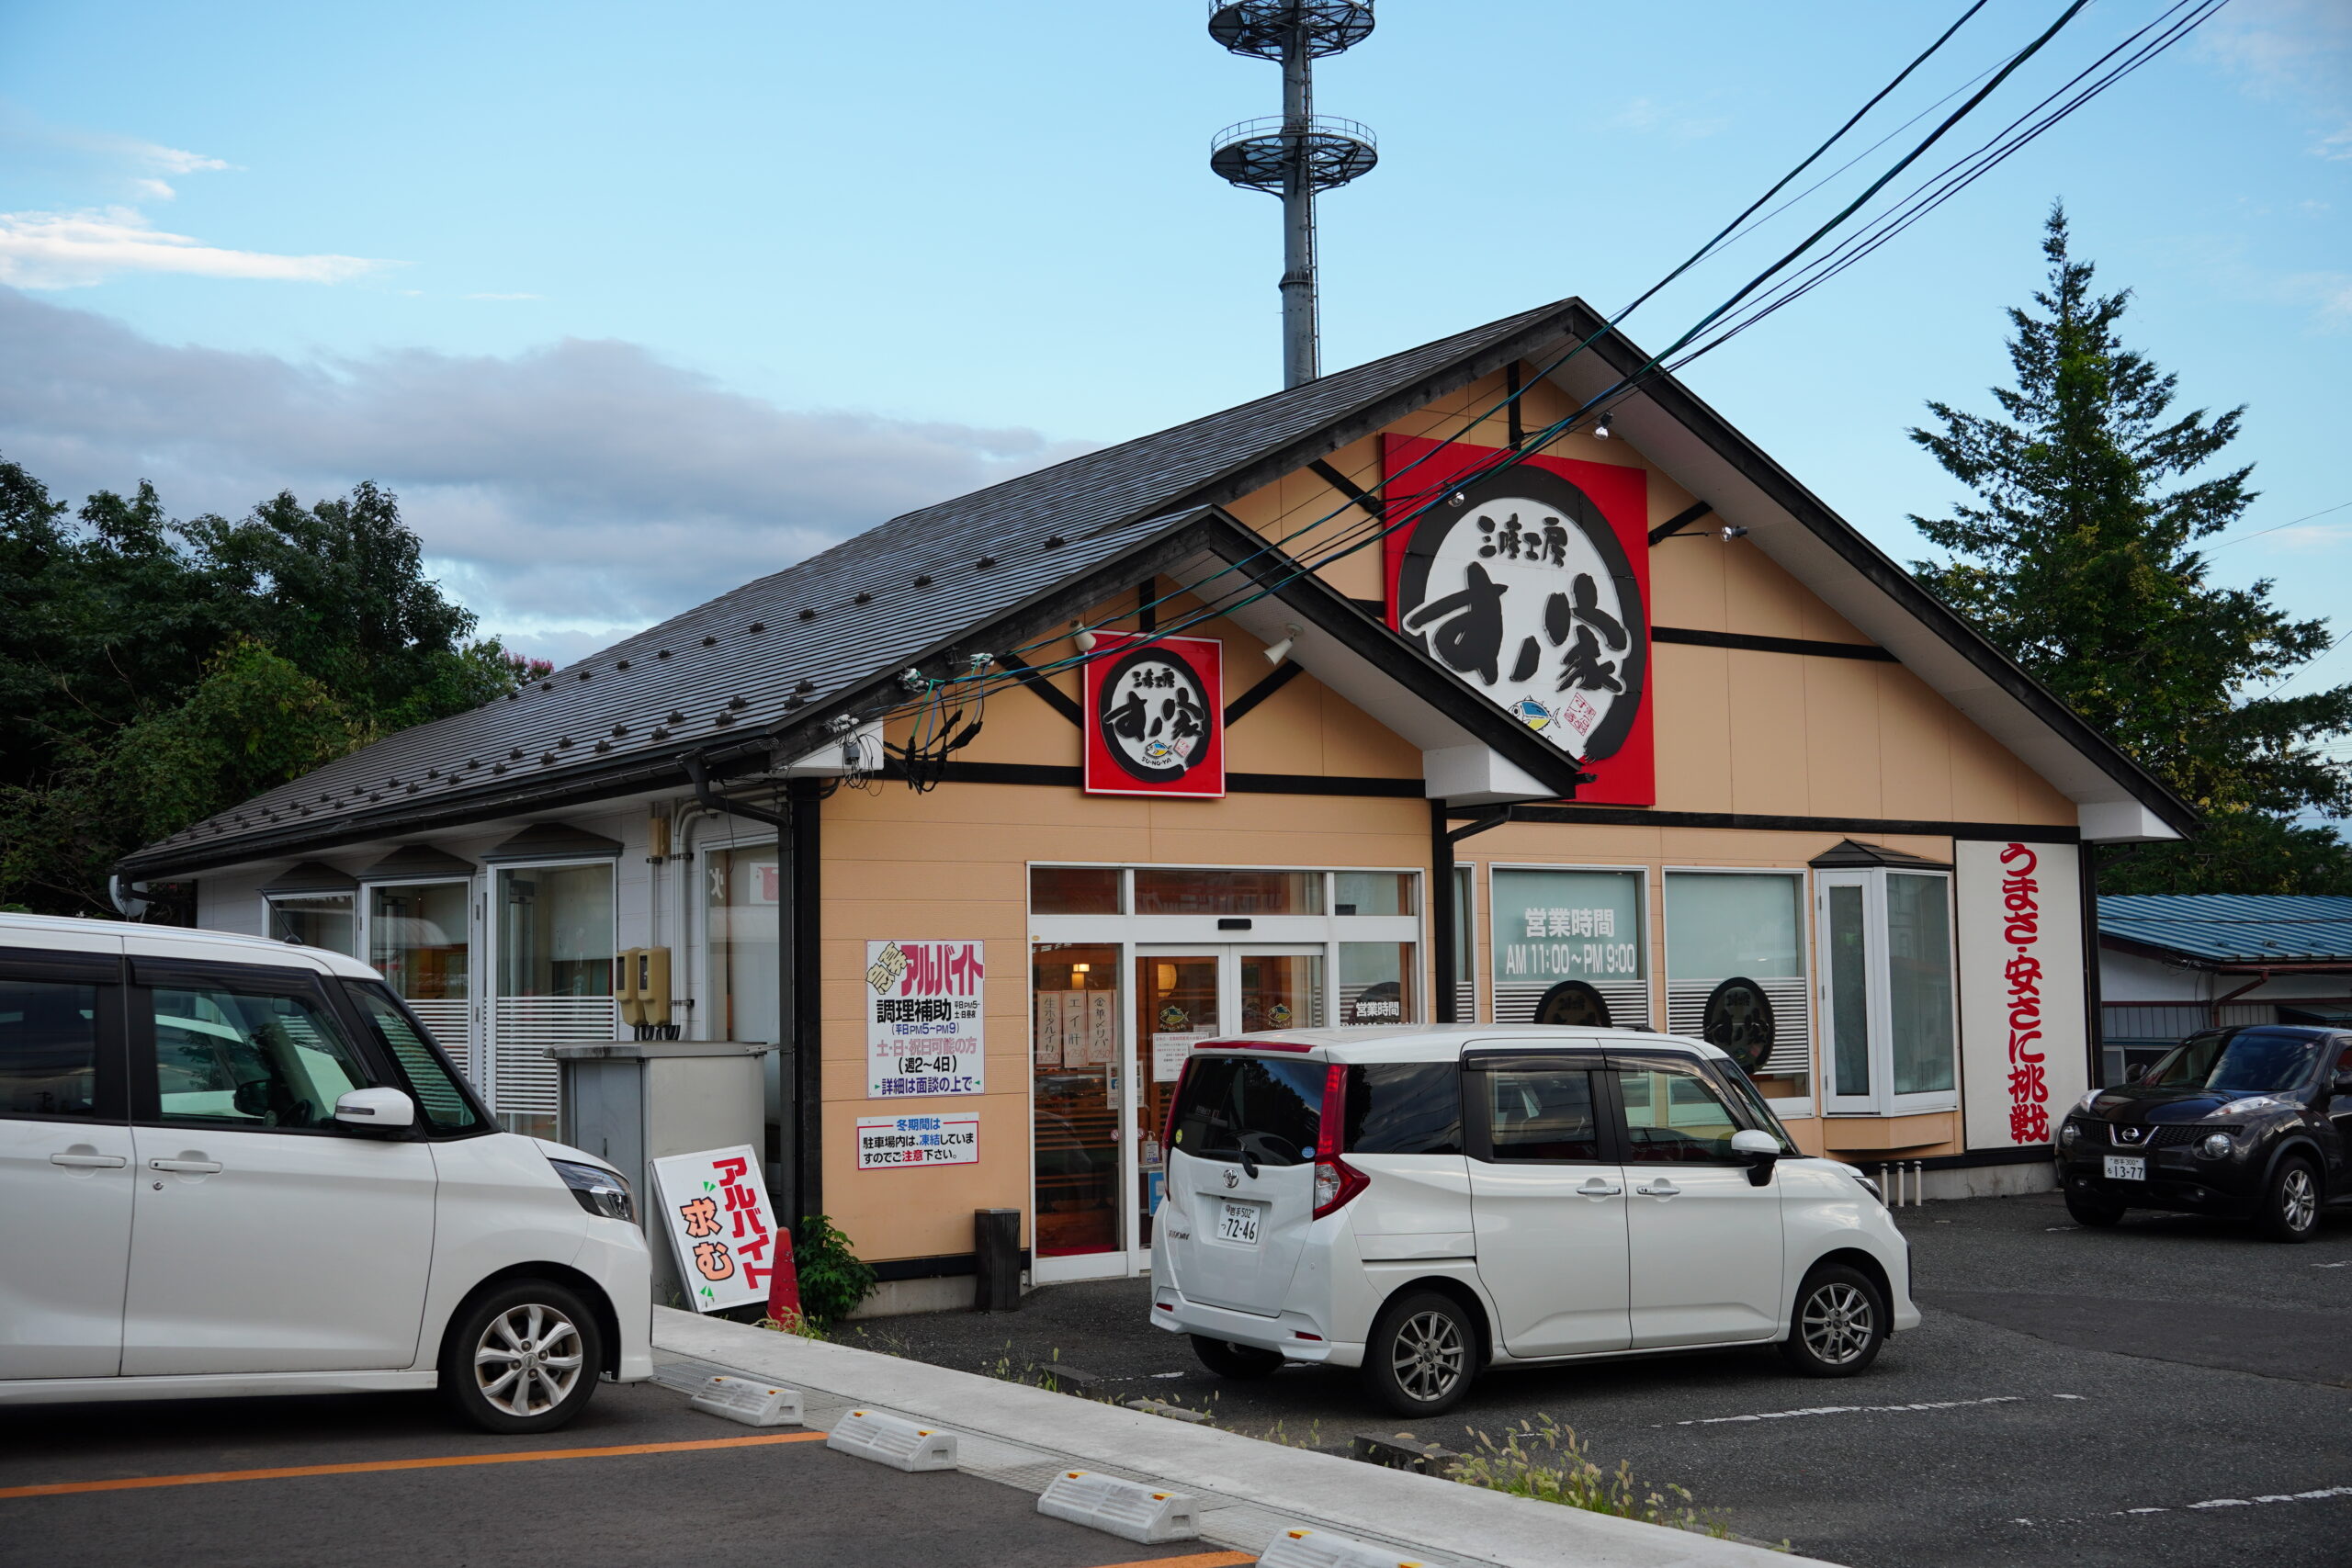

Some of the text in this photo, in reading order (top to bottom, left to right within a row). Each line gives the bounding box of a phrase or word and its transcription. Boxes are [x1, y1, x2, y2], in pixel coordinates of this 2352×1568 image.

[1525, 908, 1615, 938] 営業時間
[866, 942, 908, 995] 急募
[900, 944, 983, 997] アルバイト
[2000, 842, 2050, 1145] うまさ・安さに挑戦
[876, 998, 951, 1023] 調理補助
[1356, 1001, 1399, 1017] 営業時間
[876, 1036, 977, 1056] 土・日・祝日可能の方
[882, 1076, 972, 1095] 詳細は面談の上で
[897, 1118, 940, 1132] 冬期間は
[863, 1133, 974, 1149] 駐車場内は、凍結していま
[864, 1149, 957, 1164] すのでご注意下さい。
[712, 1156, 772, 1290] アルバイト
[680, 1196, 735, 1281] 求む
